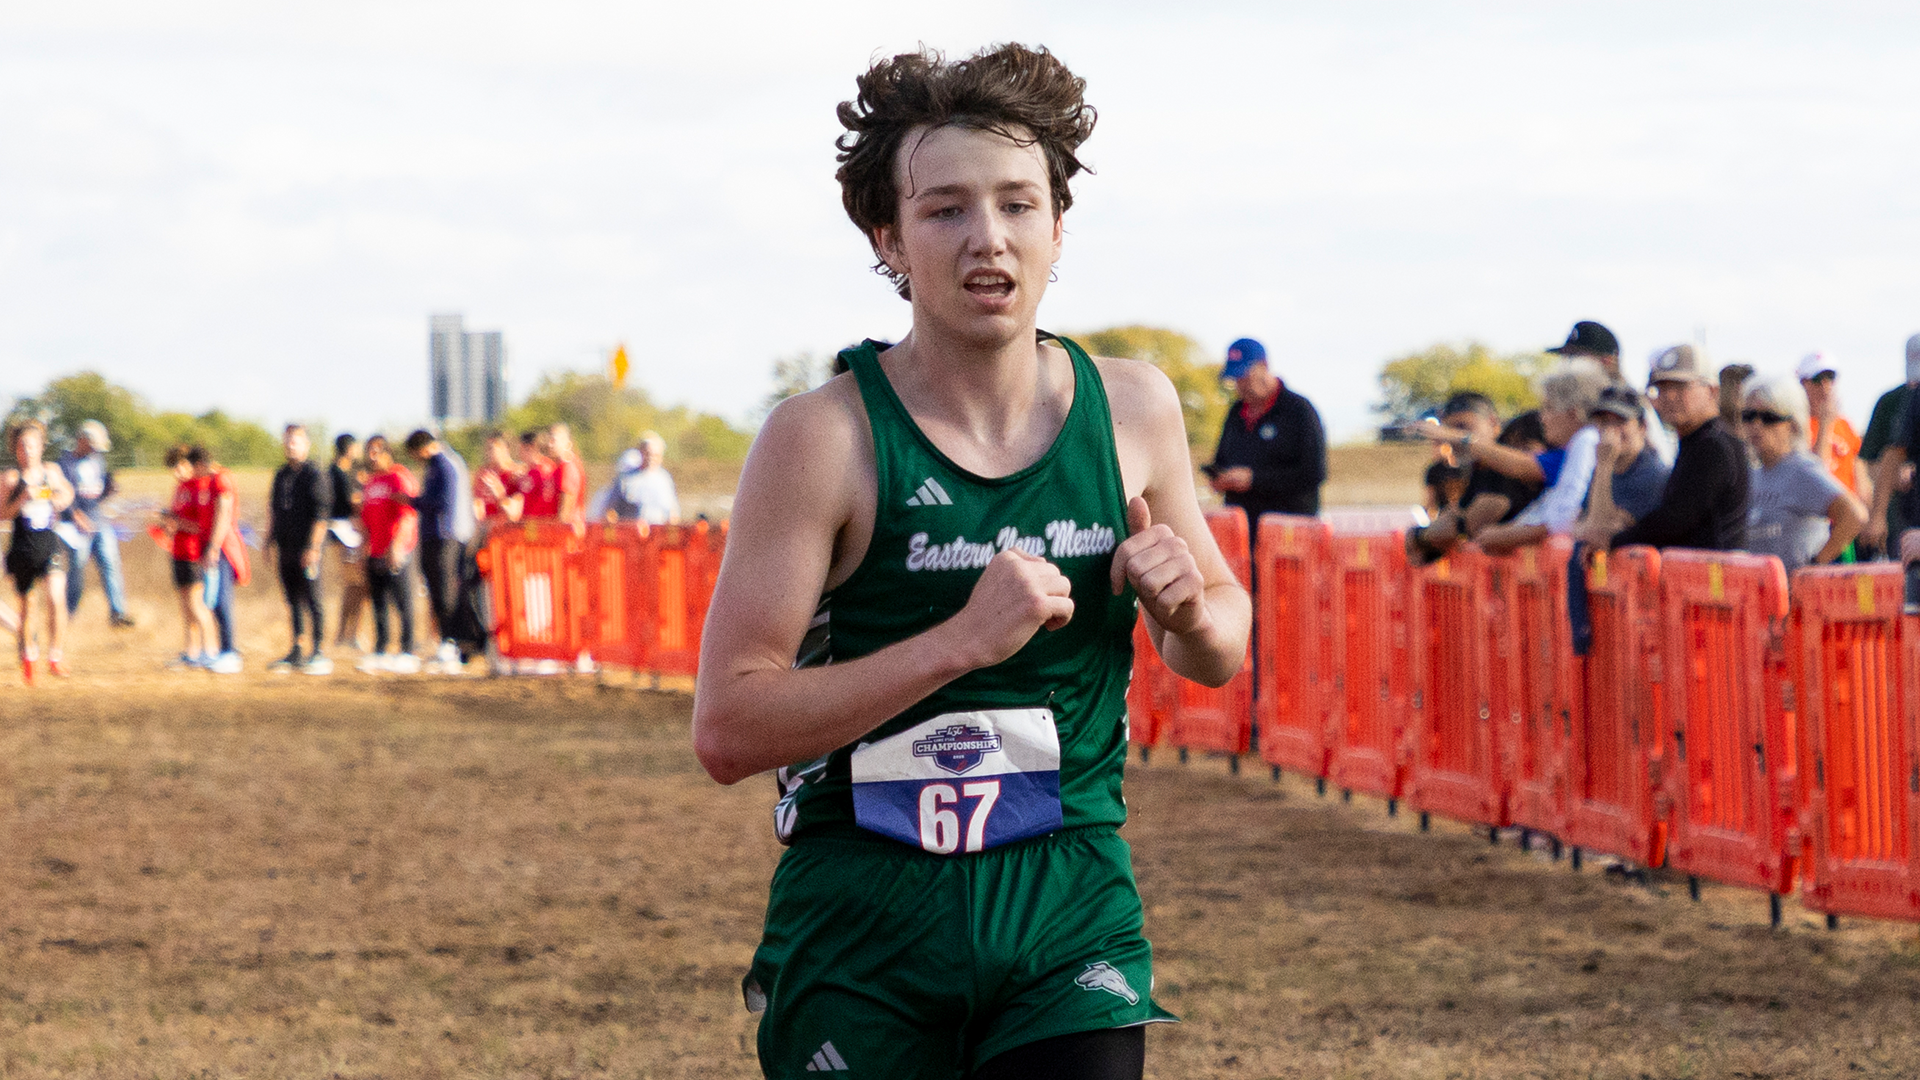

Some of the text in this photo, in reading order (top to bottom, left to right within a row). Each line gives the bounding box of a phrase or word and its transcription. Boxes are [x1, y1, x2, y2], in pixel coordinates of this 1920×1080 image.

[906, 532, 994, 571] Eastern
[1045, 519, 1115, 558] Mexico
[916, 739, 998, 753] CHAMPIONSHIPS
[919, 780, 1000, 855] 67
